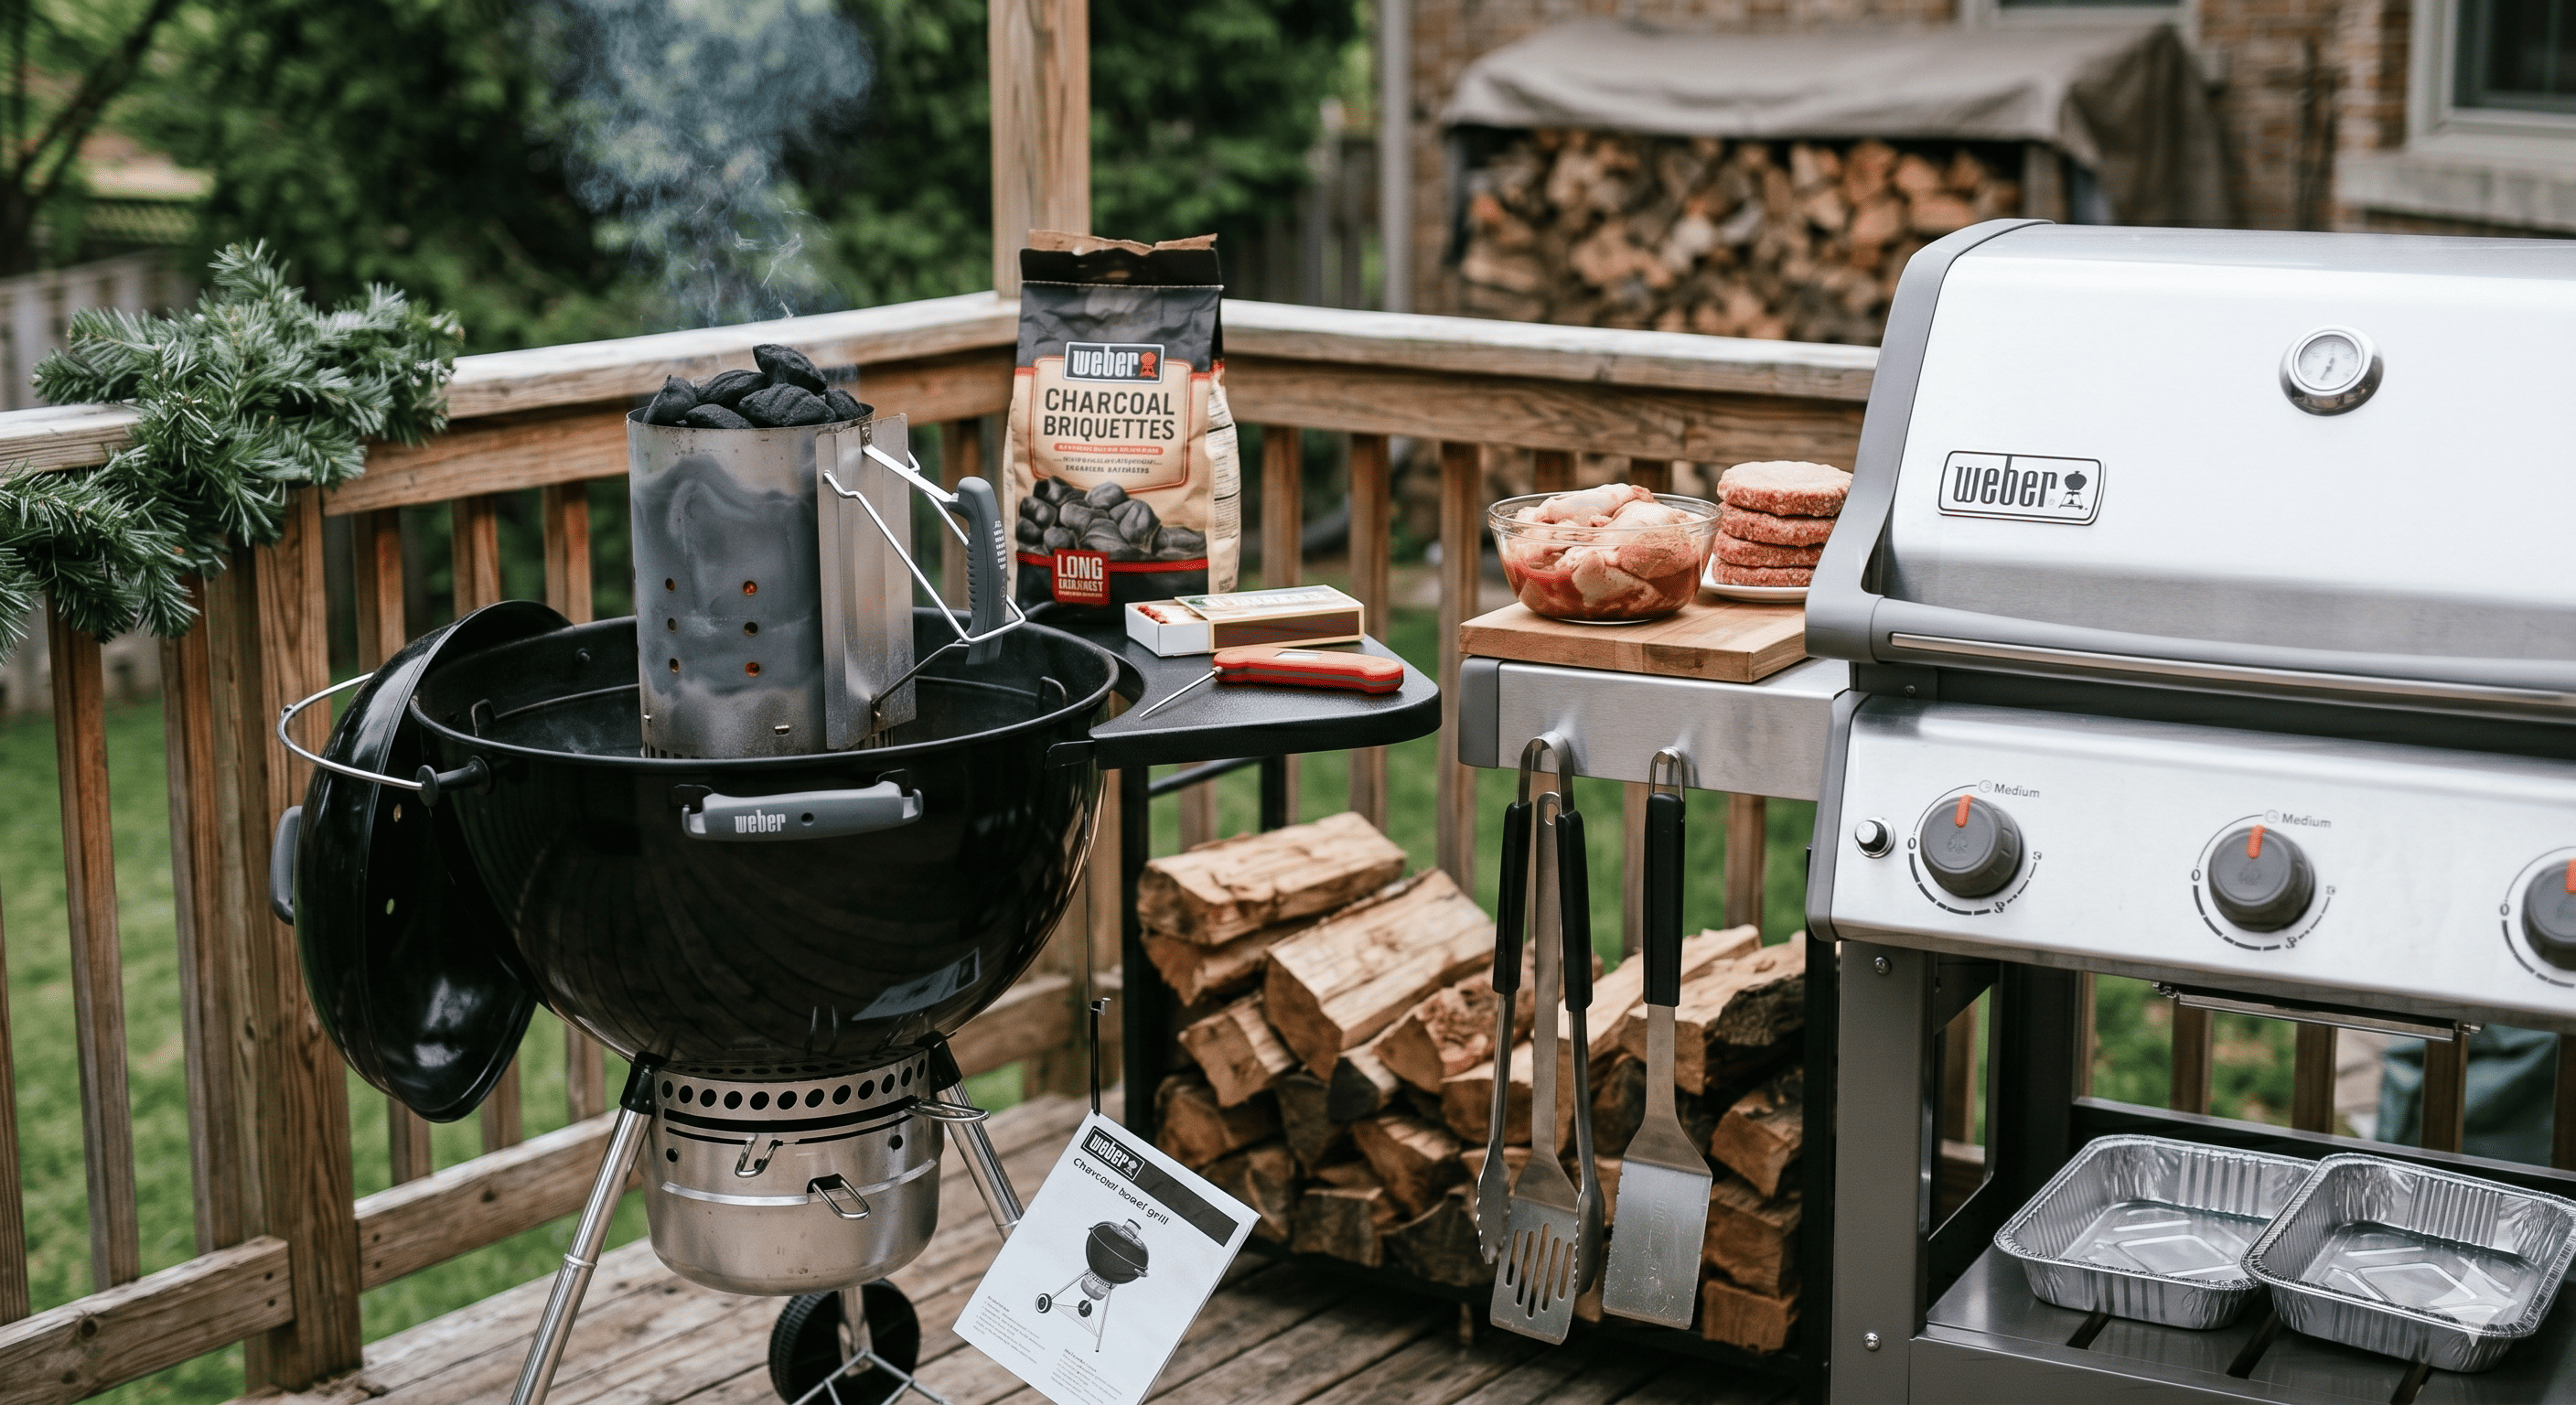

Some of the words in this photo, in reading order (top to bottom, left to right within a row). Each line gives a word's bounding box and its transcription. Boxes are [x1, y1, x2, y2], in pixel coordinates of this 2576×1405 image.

[1072, 345, 1139, 378] weber
[1045, 388, 1175, 416] CHARCOAL
[1043, 414, 1175, 442] BRIQUETTES
[1952, 455, 2058, 508] weber
[1057, 553, 1103, 580] LONG
[1993, 783, 2041, 799] Medium
[734, 810, 786, 834] weber
[2281, 813, 2332, 829] Medium
[1089, 1133, 1130, 1168] weber
